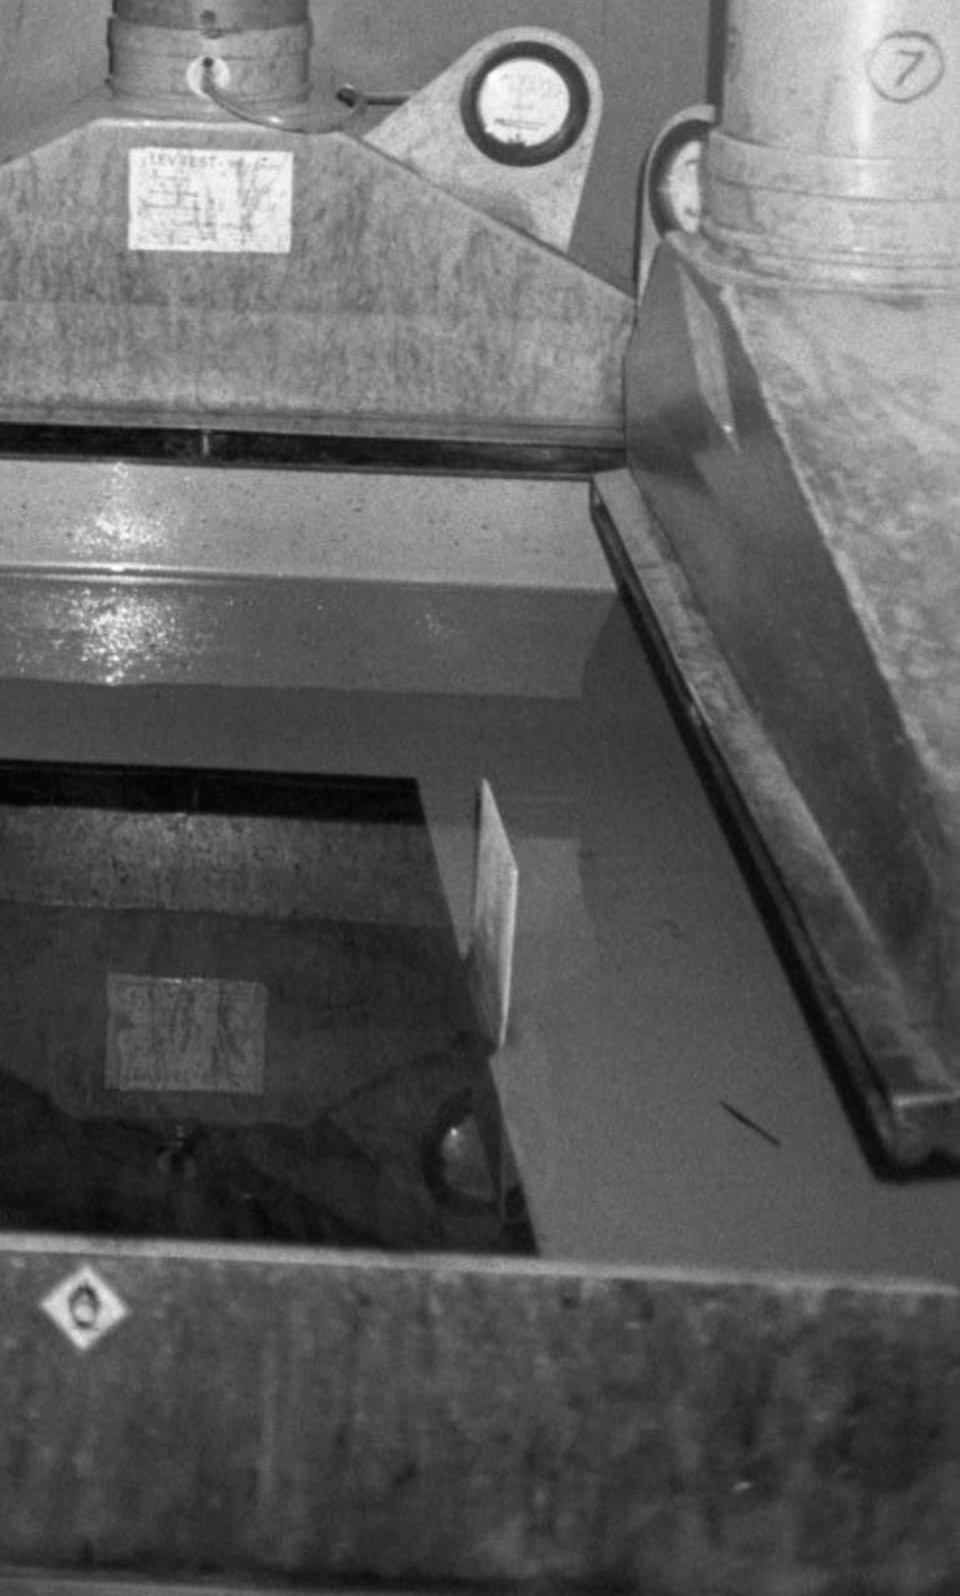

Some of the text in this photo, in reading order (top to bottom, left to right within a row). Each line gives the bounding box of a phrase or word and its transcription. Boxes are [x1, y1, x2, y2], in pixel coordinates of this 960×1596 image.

[895, 49, 926, 88] 7
[150, 152, 176, 167] LEV
[182, 154, 216, 169] TEST
